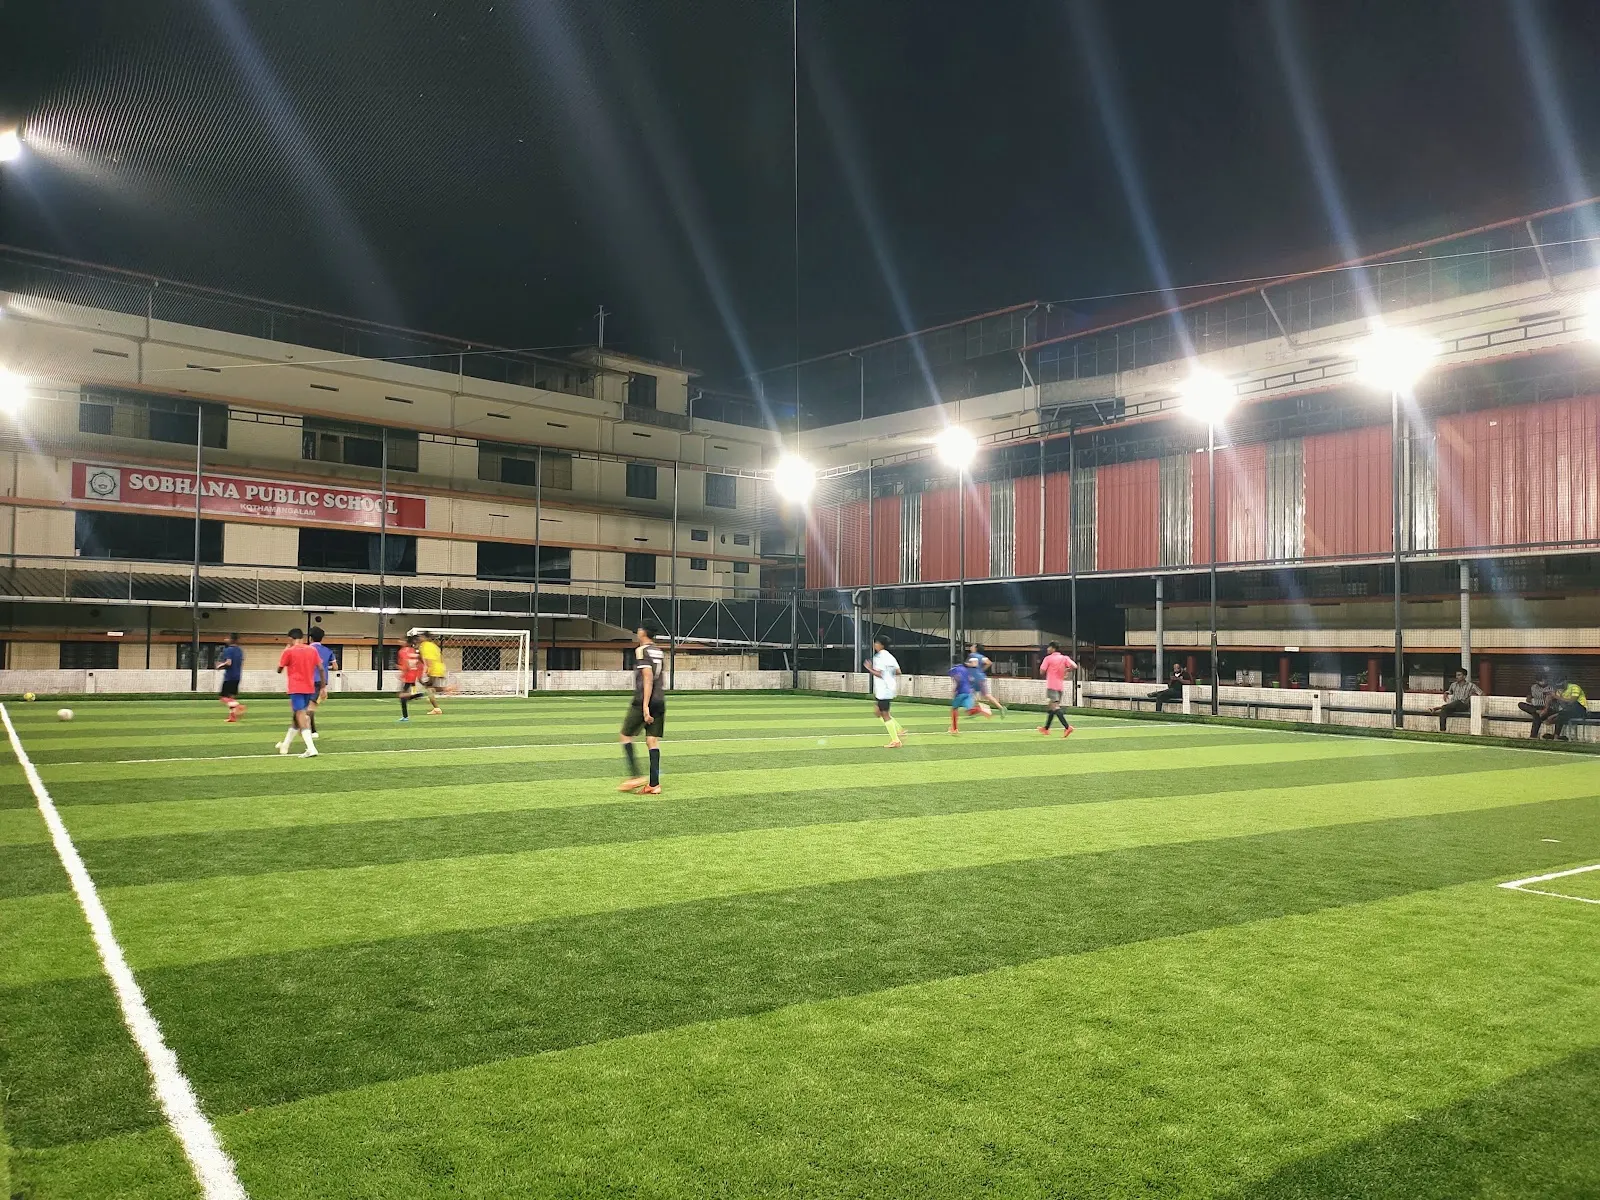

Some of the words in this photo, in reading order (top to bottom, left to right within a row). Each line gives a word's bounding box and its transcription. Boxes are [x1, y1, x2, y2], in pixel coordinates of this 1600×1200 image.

[128, 473, 240, 500] SOBHANA
[245, 485, 319, 507] PUBLIC
[323, 493, 398, 515] SCHOOL
[240, 503, 316, 516] KOTHAMANGALAM
